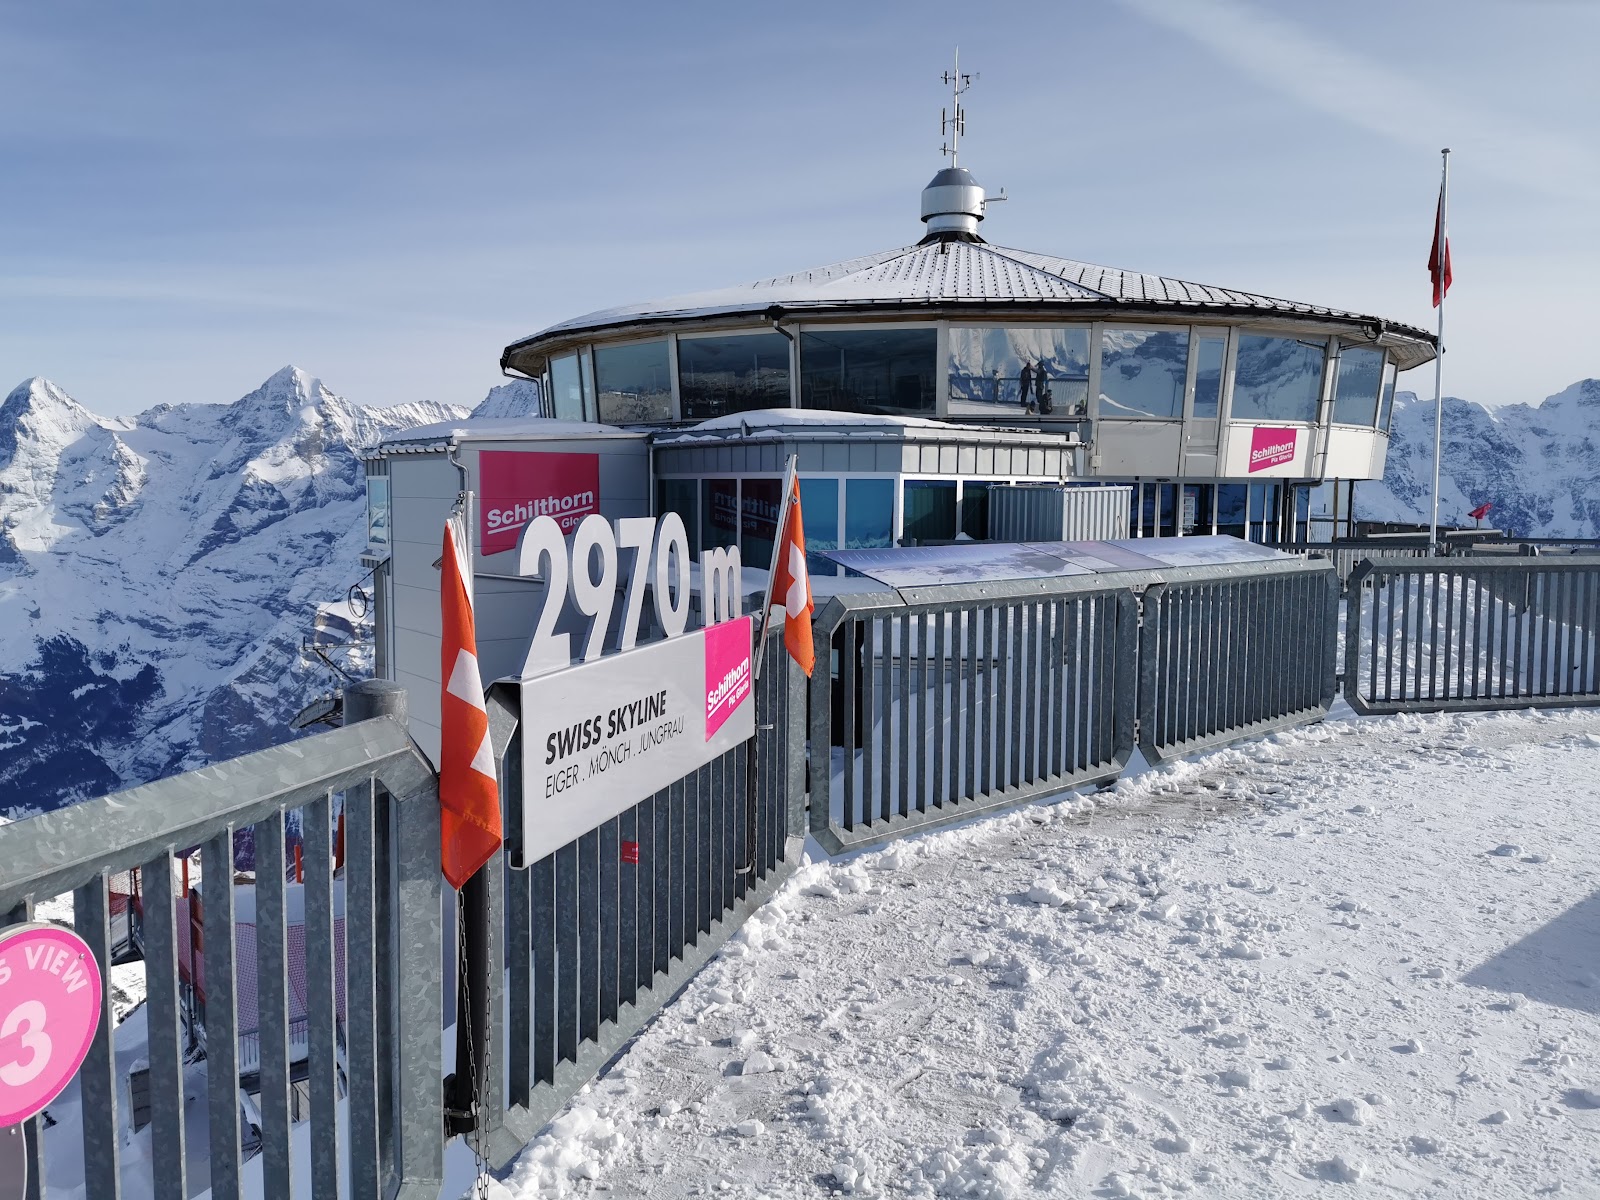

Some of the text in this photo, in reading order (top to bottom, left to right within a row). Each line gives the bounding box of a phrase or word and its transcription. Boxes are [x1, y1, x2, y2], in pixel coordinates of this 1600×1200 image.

[1252, 442, 1293, 460] Schilthorn
[1279, 453, 1292, 461] Gloria
[487, 490, 593, 528] Schilthorn
[517, 511, 742, 679] 2970 m
[707, 657, 749, 711] Schilthorn
[545, 689, 667, 765] SWISS SKYLINE
[545, 715, 684, 799] EIGER MÖNCH JUNGFRAU
[25, 944, 88, 994] VIEW
[0, 1000, 52, 1087] 3
